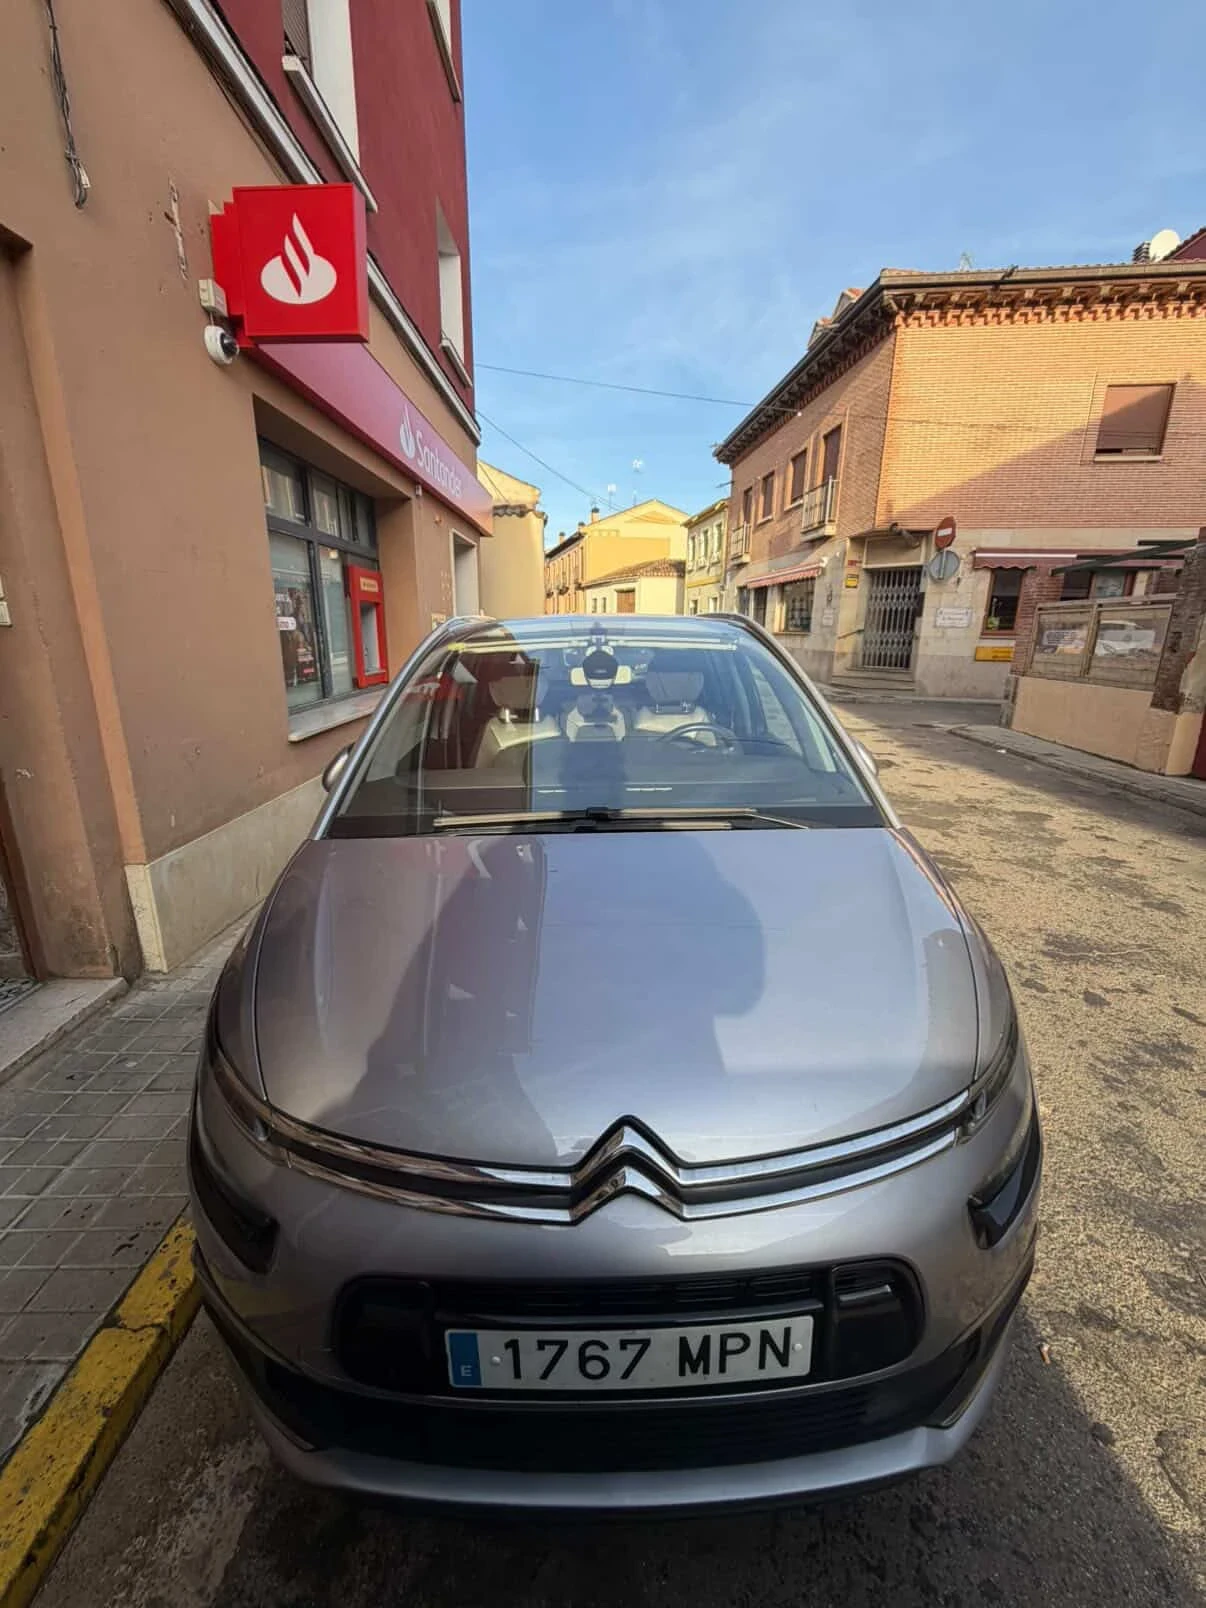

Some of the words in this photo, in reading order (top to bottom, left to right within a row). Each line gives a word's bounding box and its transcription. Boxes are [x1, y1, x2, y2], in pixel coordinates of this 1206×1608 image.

[460, 1364, 472, 1377] E
[504, 1337, 651, 1381] 1767
[678, 1327, 792, 1377] MPN
